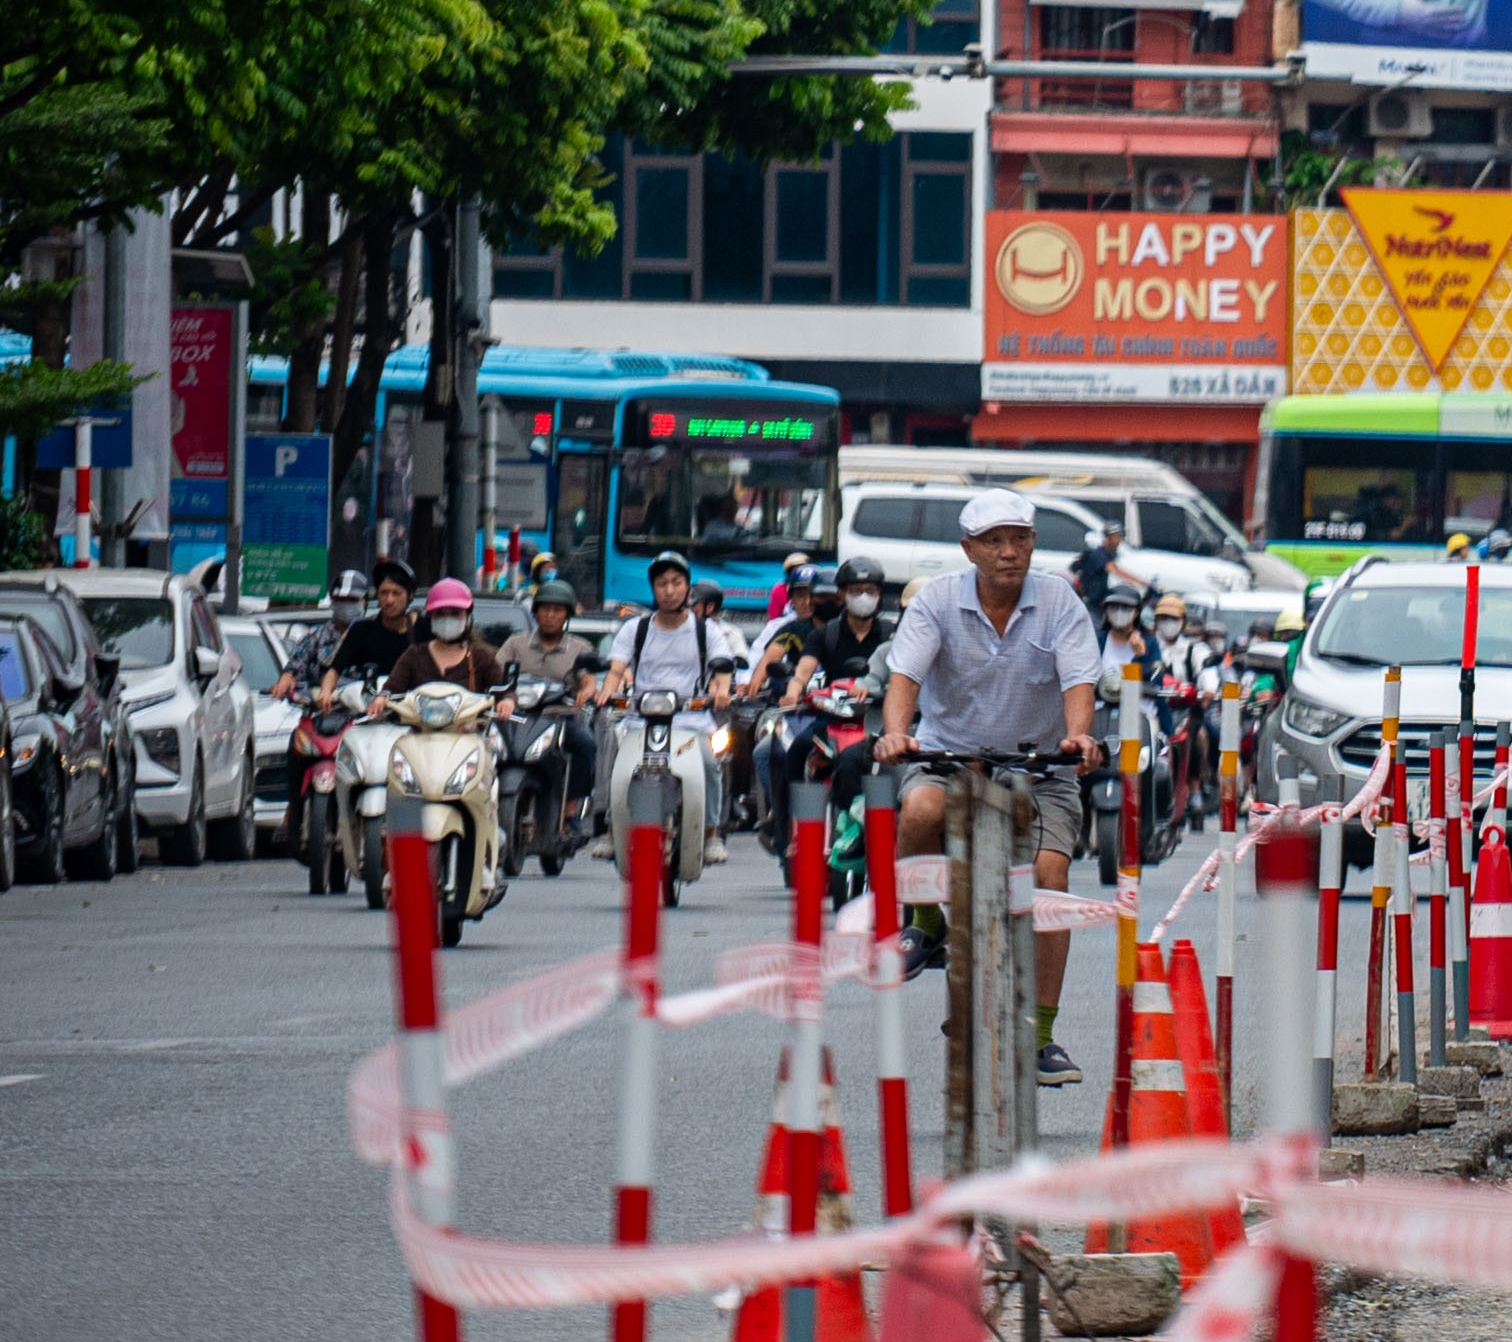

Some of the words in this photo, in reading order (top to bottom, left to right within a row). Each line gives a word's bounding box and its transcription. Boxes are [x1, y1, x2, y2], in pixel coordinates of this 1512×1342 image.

[1095, 221, 1275, 267] HAPPY
[1093, 277, 1279, 323] MONEY
[274, 445, 299, 478] P
